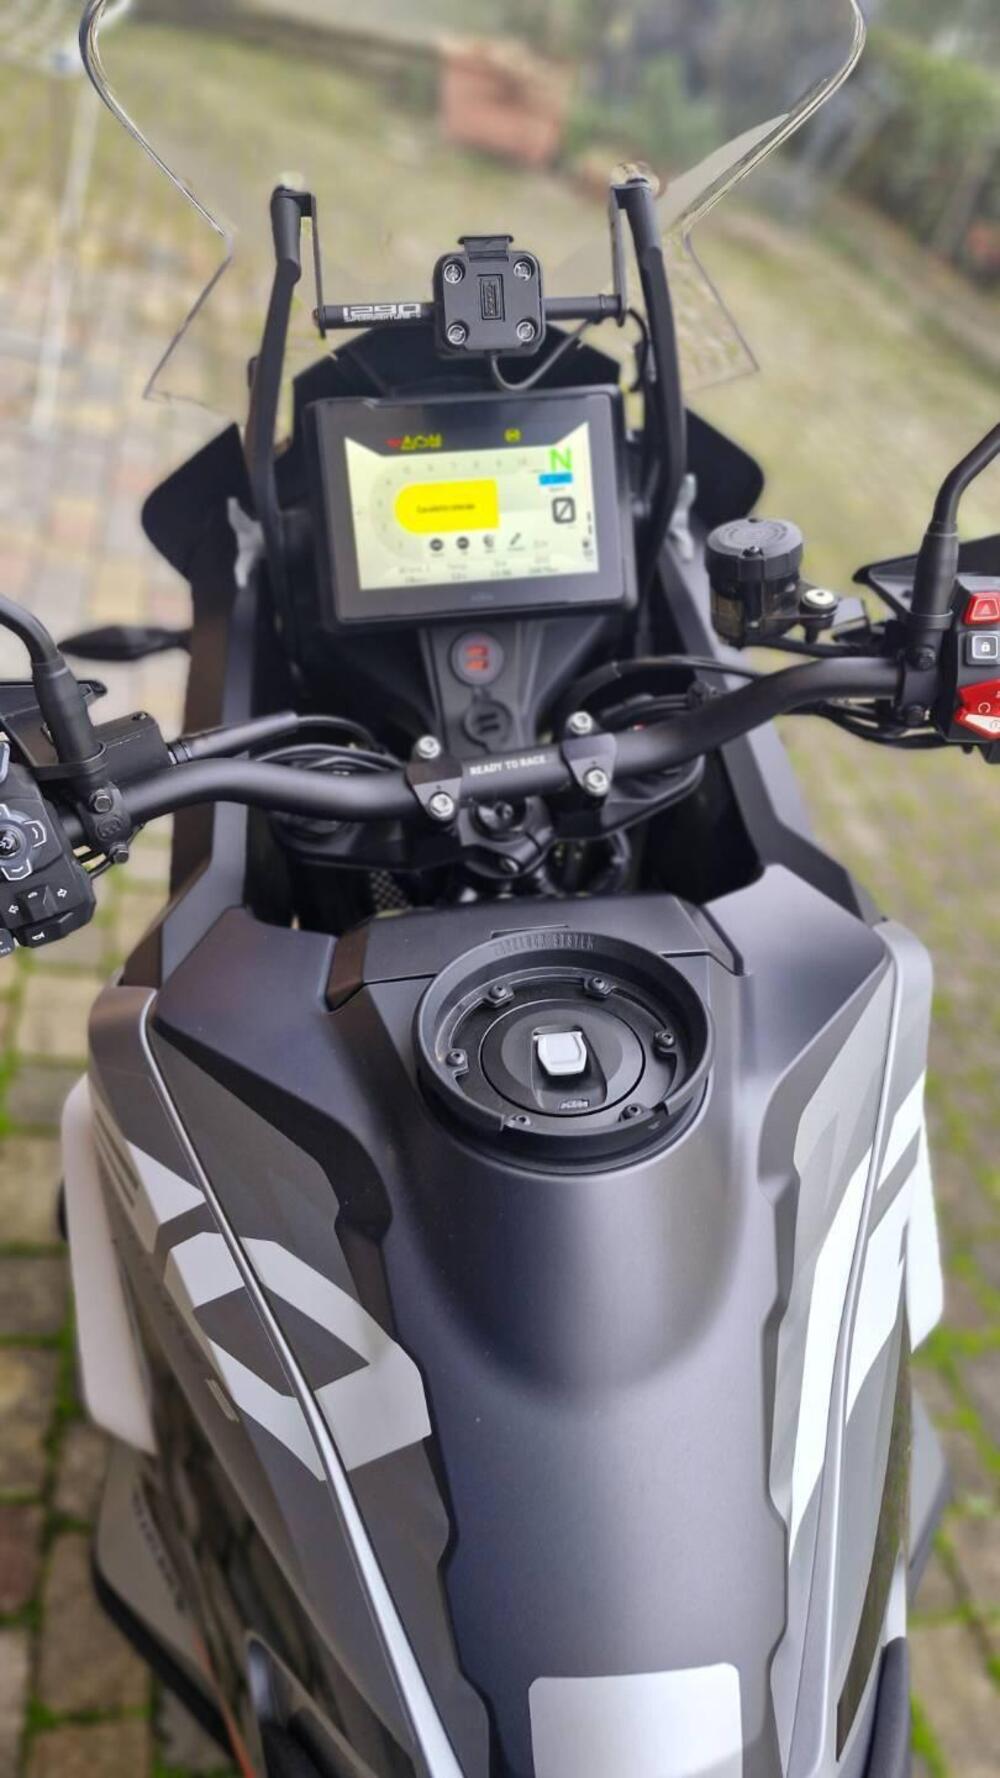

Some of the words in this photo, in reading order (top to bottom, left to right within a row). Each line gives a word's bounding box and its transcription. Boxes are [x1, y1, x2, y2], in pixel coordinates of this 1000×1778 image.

[343, 304, 421, 317] 1290
[549, 447, 573, 472] N
[469, 763, 502, 775] READY
[505, 760, 519, 770] TO
[520, 755, 546, 767] RACE
